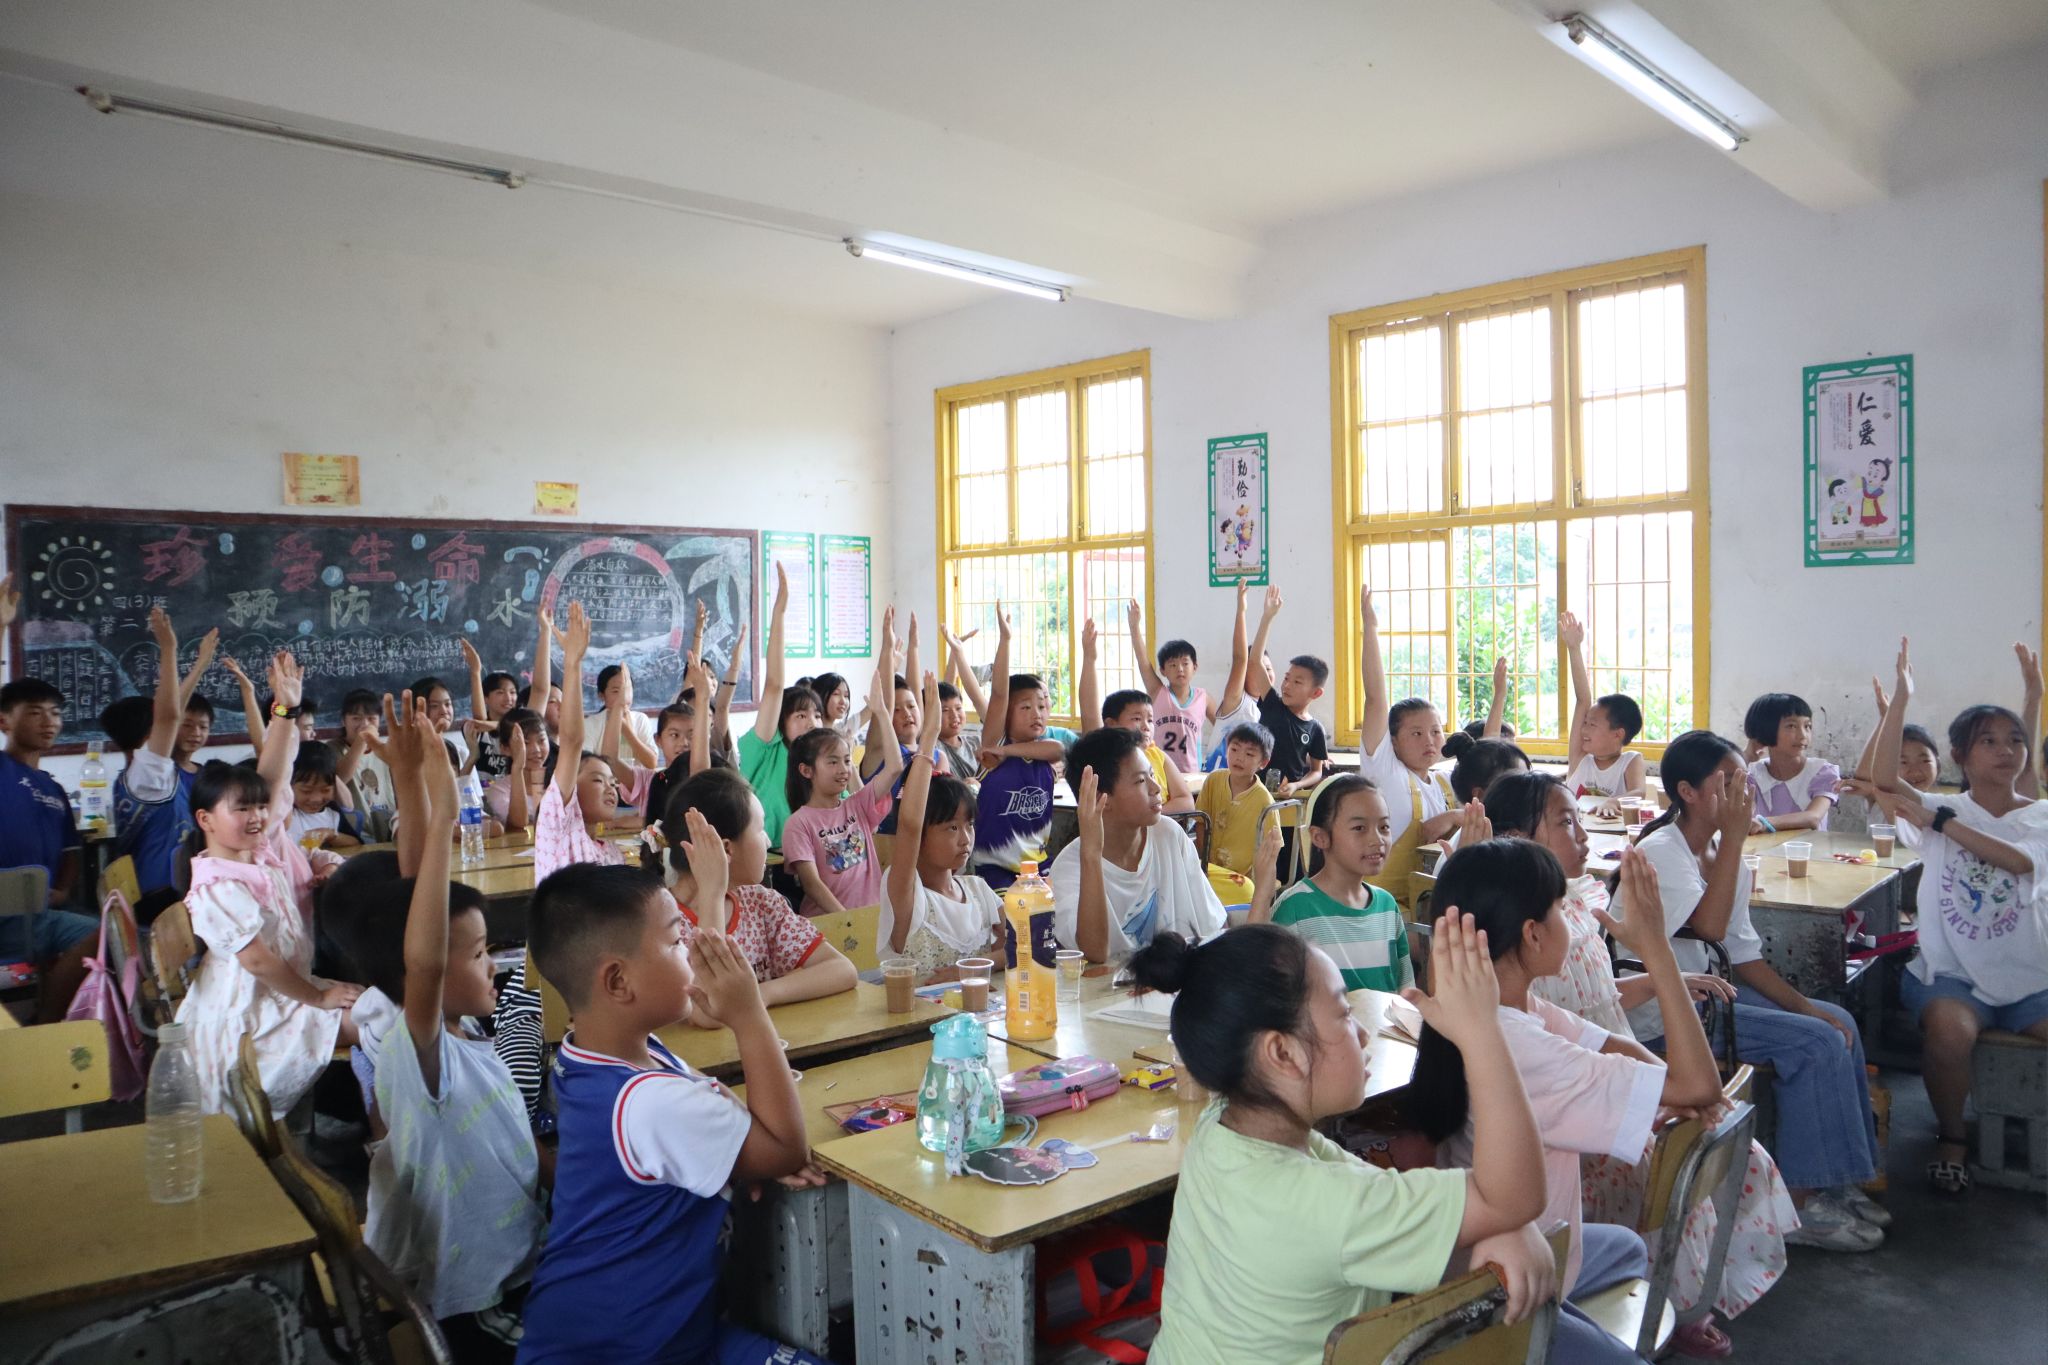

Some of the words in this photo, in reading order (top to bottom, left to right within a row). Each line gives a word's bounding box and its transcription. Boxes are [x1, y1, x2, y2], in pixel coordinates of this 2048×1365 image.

[140, 526, 486, 596] 珍爱生命
[226, 577, 531, 630] 预防溺水
[1163, 731, 1187, 754] 24
[1940, 898, 1980, 940] SINCE
